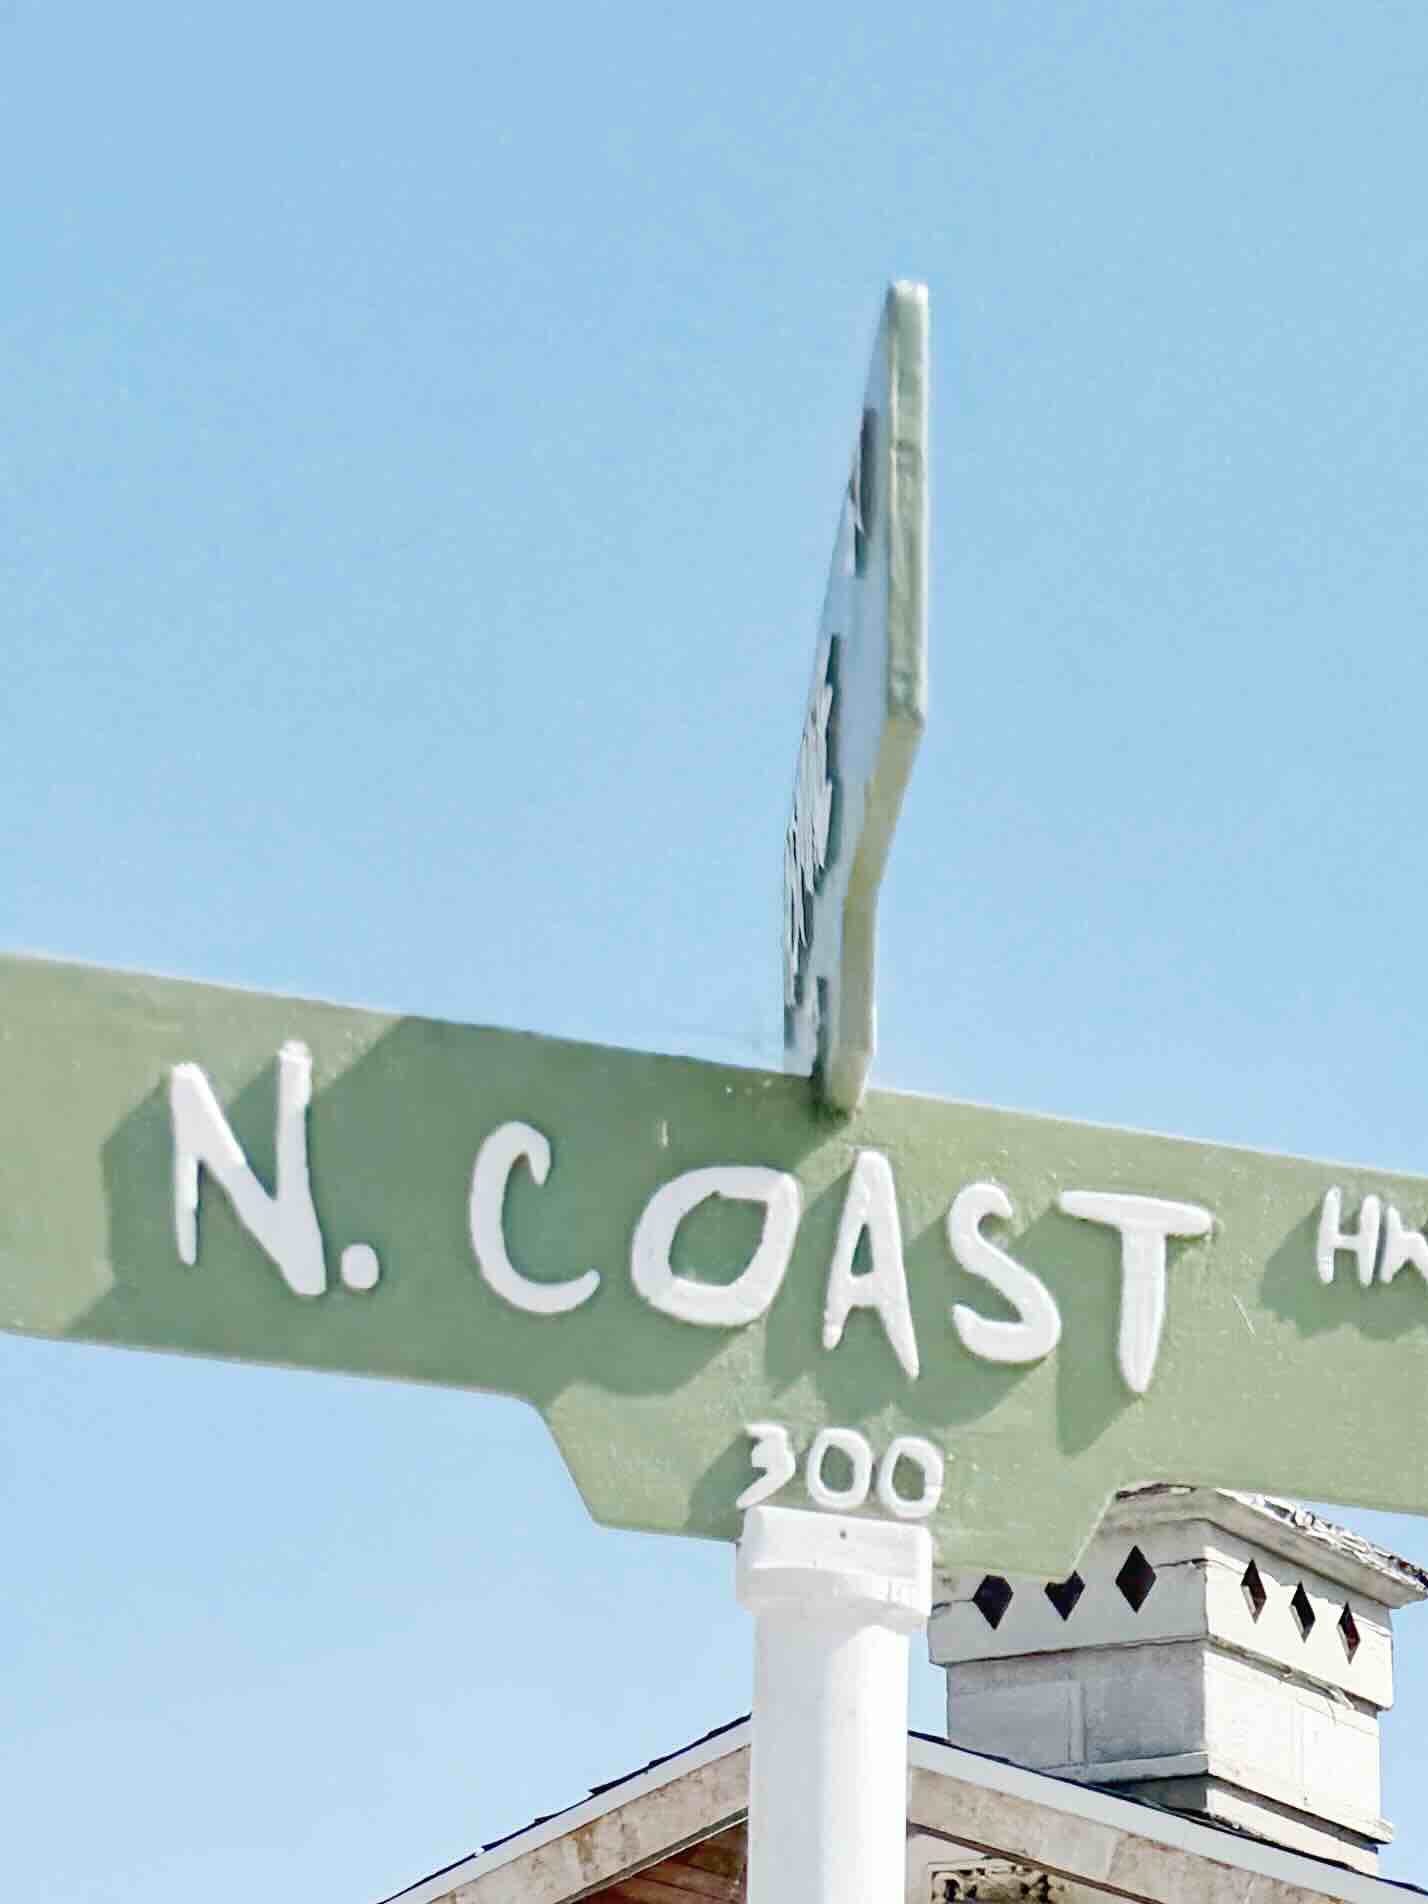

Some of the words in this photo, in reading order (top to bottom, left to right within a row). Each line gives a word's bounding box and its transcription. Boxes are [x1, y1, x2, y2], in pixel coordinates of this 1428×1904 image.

[171, 1040, 381, 1297] N.
[470, 1121, 1214, 1394] COAST
[737, 1423, 945, 1519] 300
